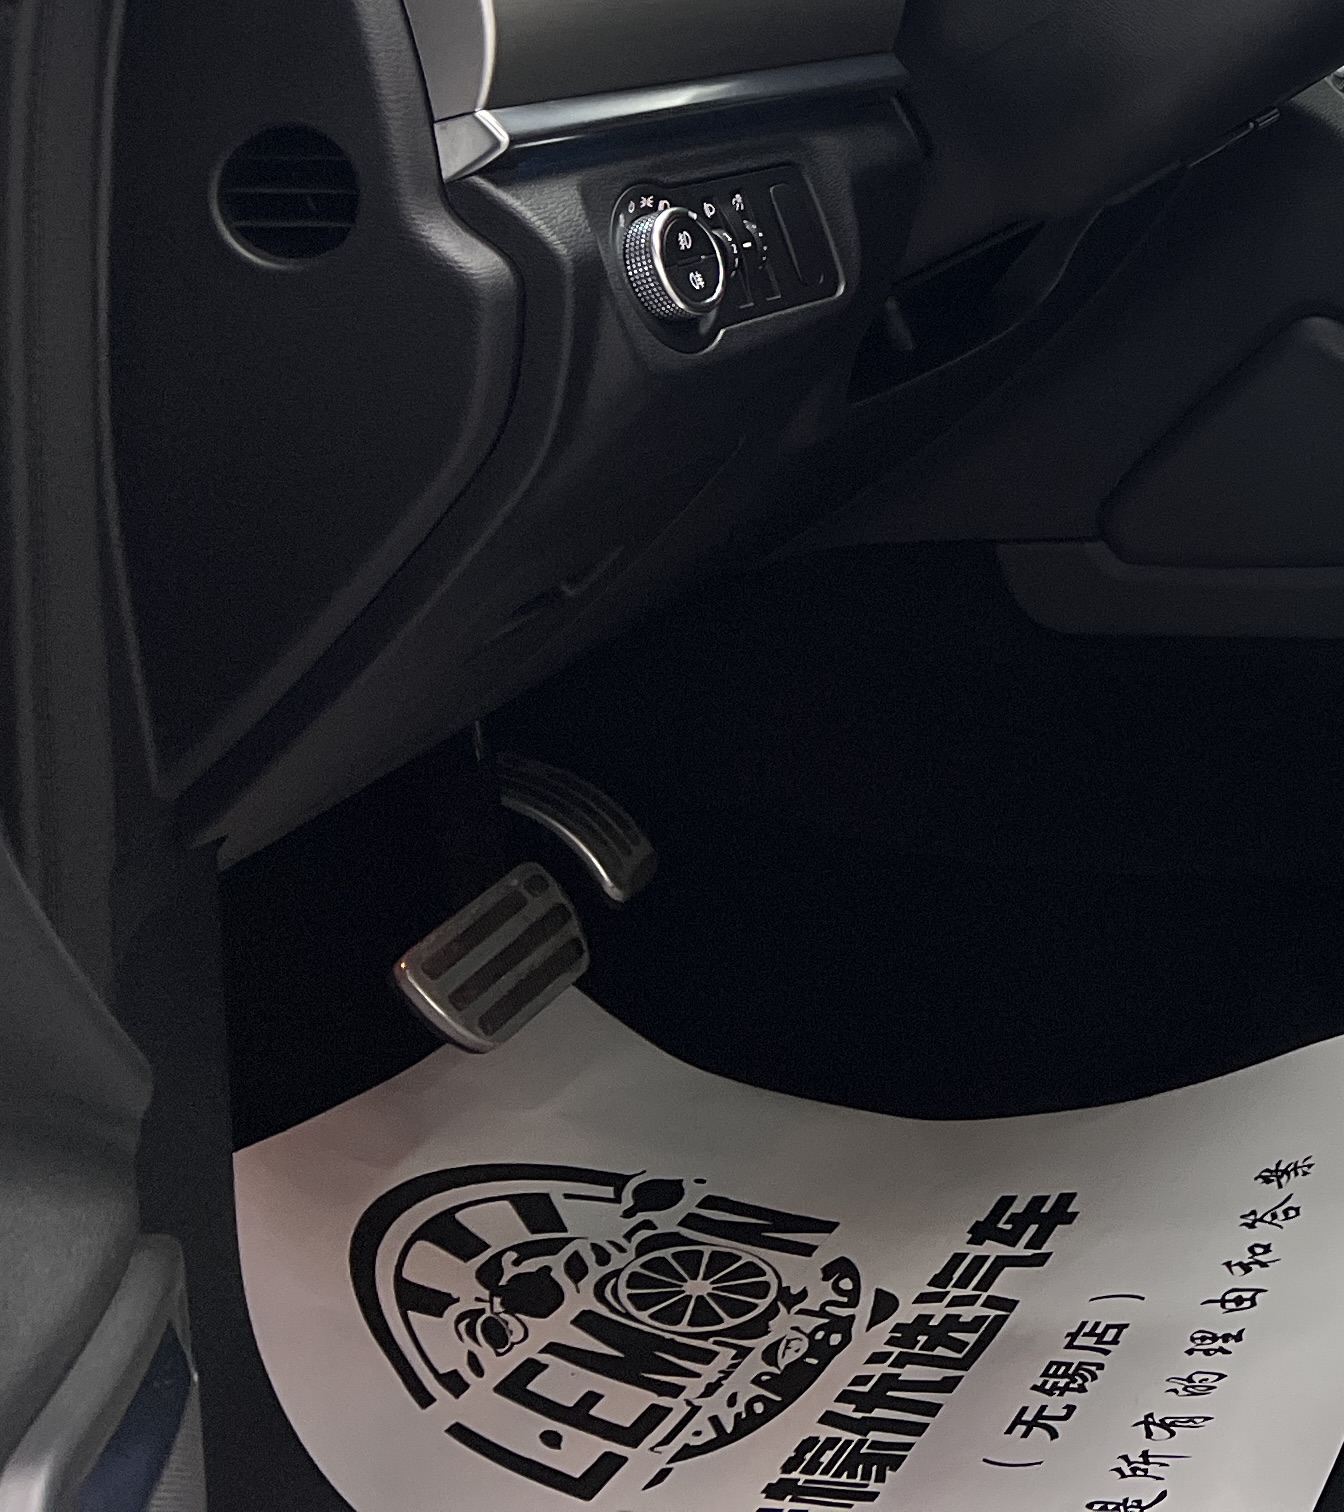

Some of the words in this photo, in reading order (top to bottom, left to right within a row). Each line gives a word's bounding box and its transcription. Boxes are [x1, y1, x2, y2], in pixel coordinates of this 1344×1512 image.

[754, 1192, 1081, 1512] 檬优选汽车
